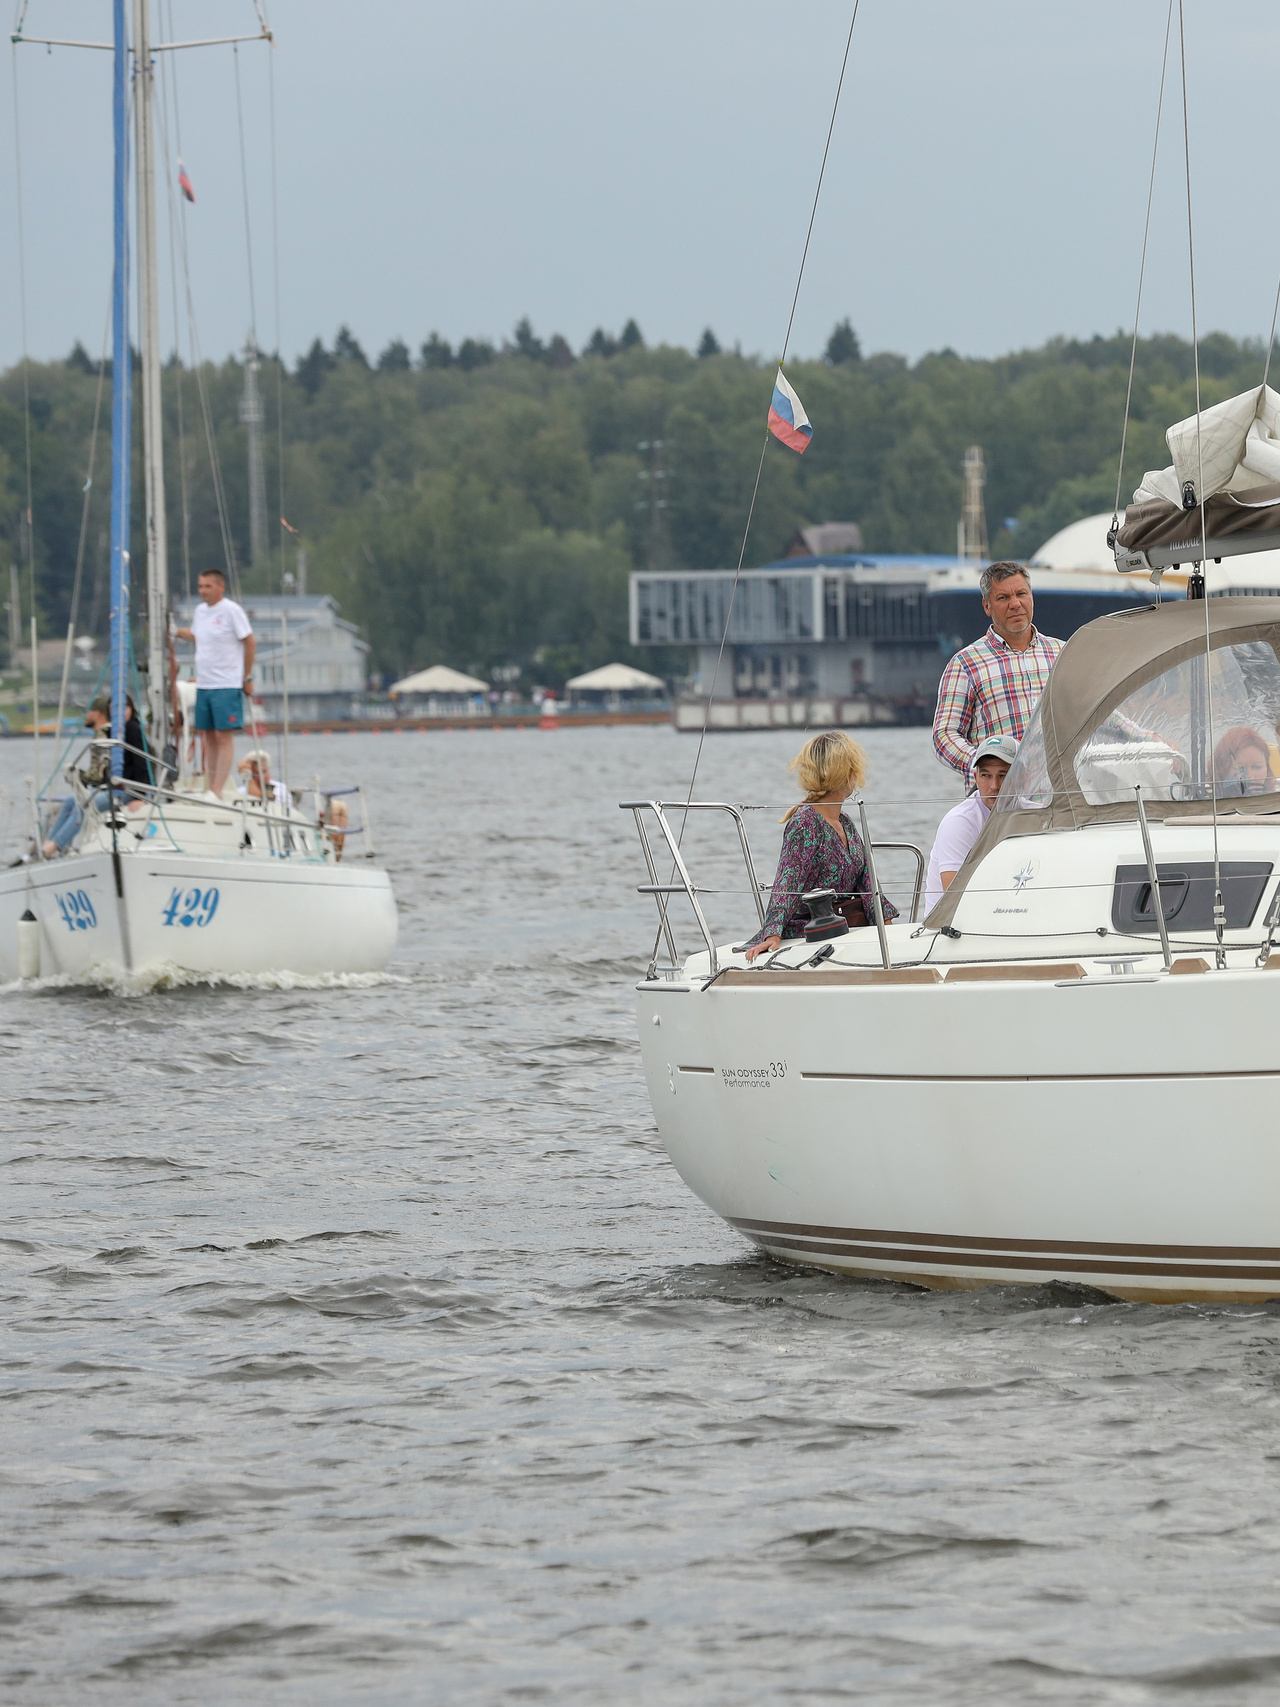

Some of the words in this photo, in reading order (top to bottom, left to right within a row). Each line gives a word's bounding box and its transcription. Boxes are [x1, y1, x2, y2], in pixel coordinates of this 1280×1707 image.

[55, 888, 97, 931] 429
[161, 886, 219, 928] 429
[721, 1068, 736, 1078] SUN
[737, 1069, 770, 1078] ODYSSEY
[769, 1059, 788, 1078] 33i
[724, 1078, 771, 1088] Performance
